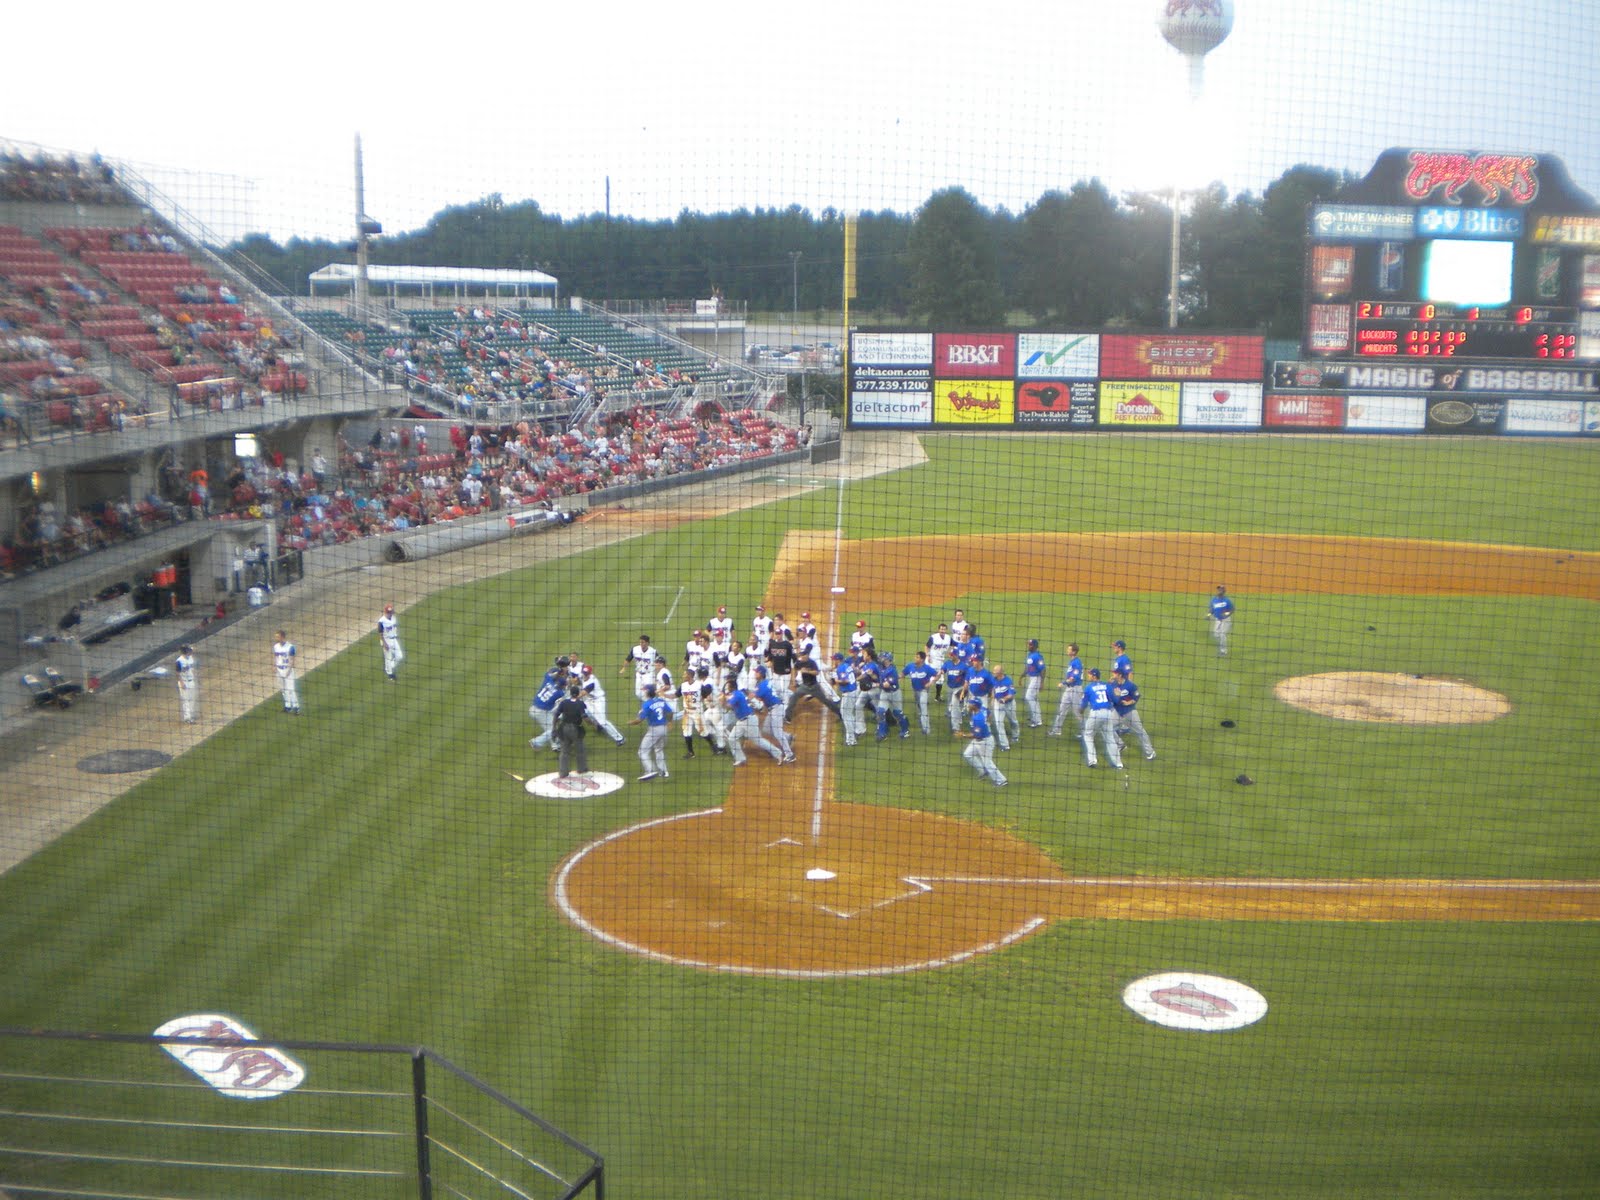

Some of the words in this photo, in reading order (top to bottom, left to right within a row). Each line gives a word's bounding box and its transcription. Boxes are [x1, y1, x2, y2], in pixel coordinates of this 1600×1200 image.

[1337, 211, 1365, 222] TIME
[1367, 212, 1414, 224] WARNER
[1463, 209, 1520, 233] Blue
[1336, 224, 1373, 232] CABLE
[1385, 306, 1395, 315] AT
[1397, 306, 1411, 315] BAT
[947, 344, 1005, 364] BB&T
[854, 367, 930, 376] deltacom.com
[1151, 365, 1171, 375] FEEL
[1190, 365, 1212, 375] LOVE
[855, 381, 930, 390] 877.239.1200
[1349, 367, 1435, 388] MAGIC
[1441, 369, 1462, 389] of
[1468, 369, 1600, 392] BASEBALL
[854, 402, 921, 413] deltacom
[1095, 690, 1109, 703] 31
[654, 707, 664, 721] 3
